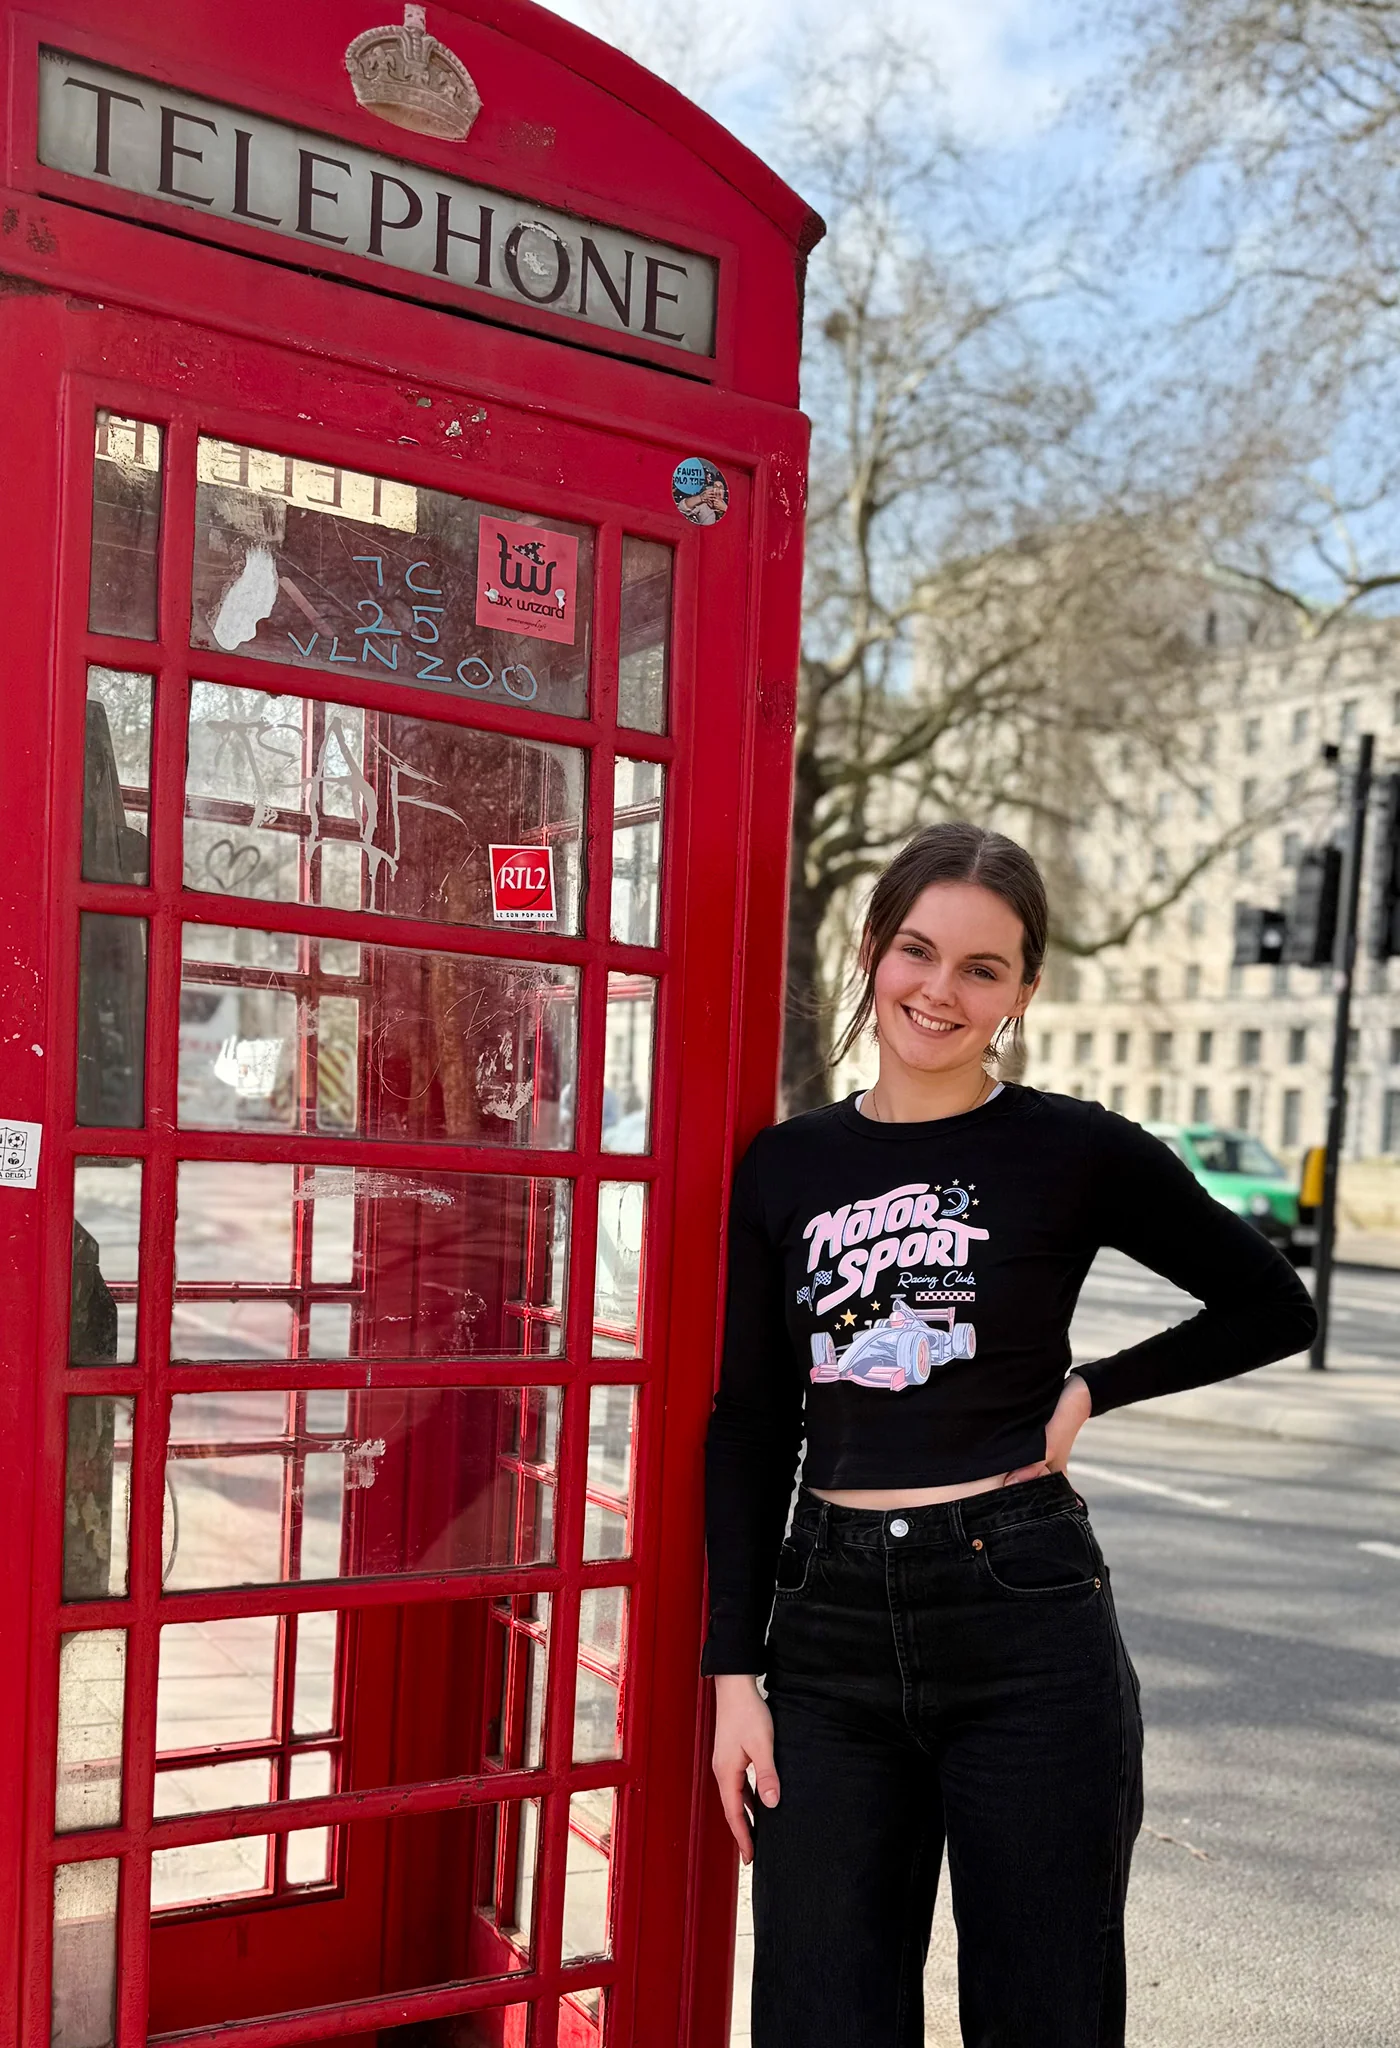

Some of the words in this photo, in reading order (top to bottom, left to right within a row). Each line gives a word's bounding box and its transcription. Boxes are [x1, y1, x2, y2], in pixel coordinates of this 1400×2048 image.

[63, 76, 689, 343] TELEPHONE
[677, 467, 702, 477] FAUSTI
[500, 866, 547, 889] RTL2
[803, 1183, 940, 1274] MOTOR
[816, 1218, 990, 1316] SPORT
[897, 1271, 940, 1289] Racing
[942, 1270, 977, 1288] Club
